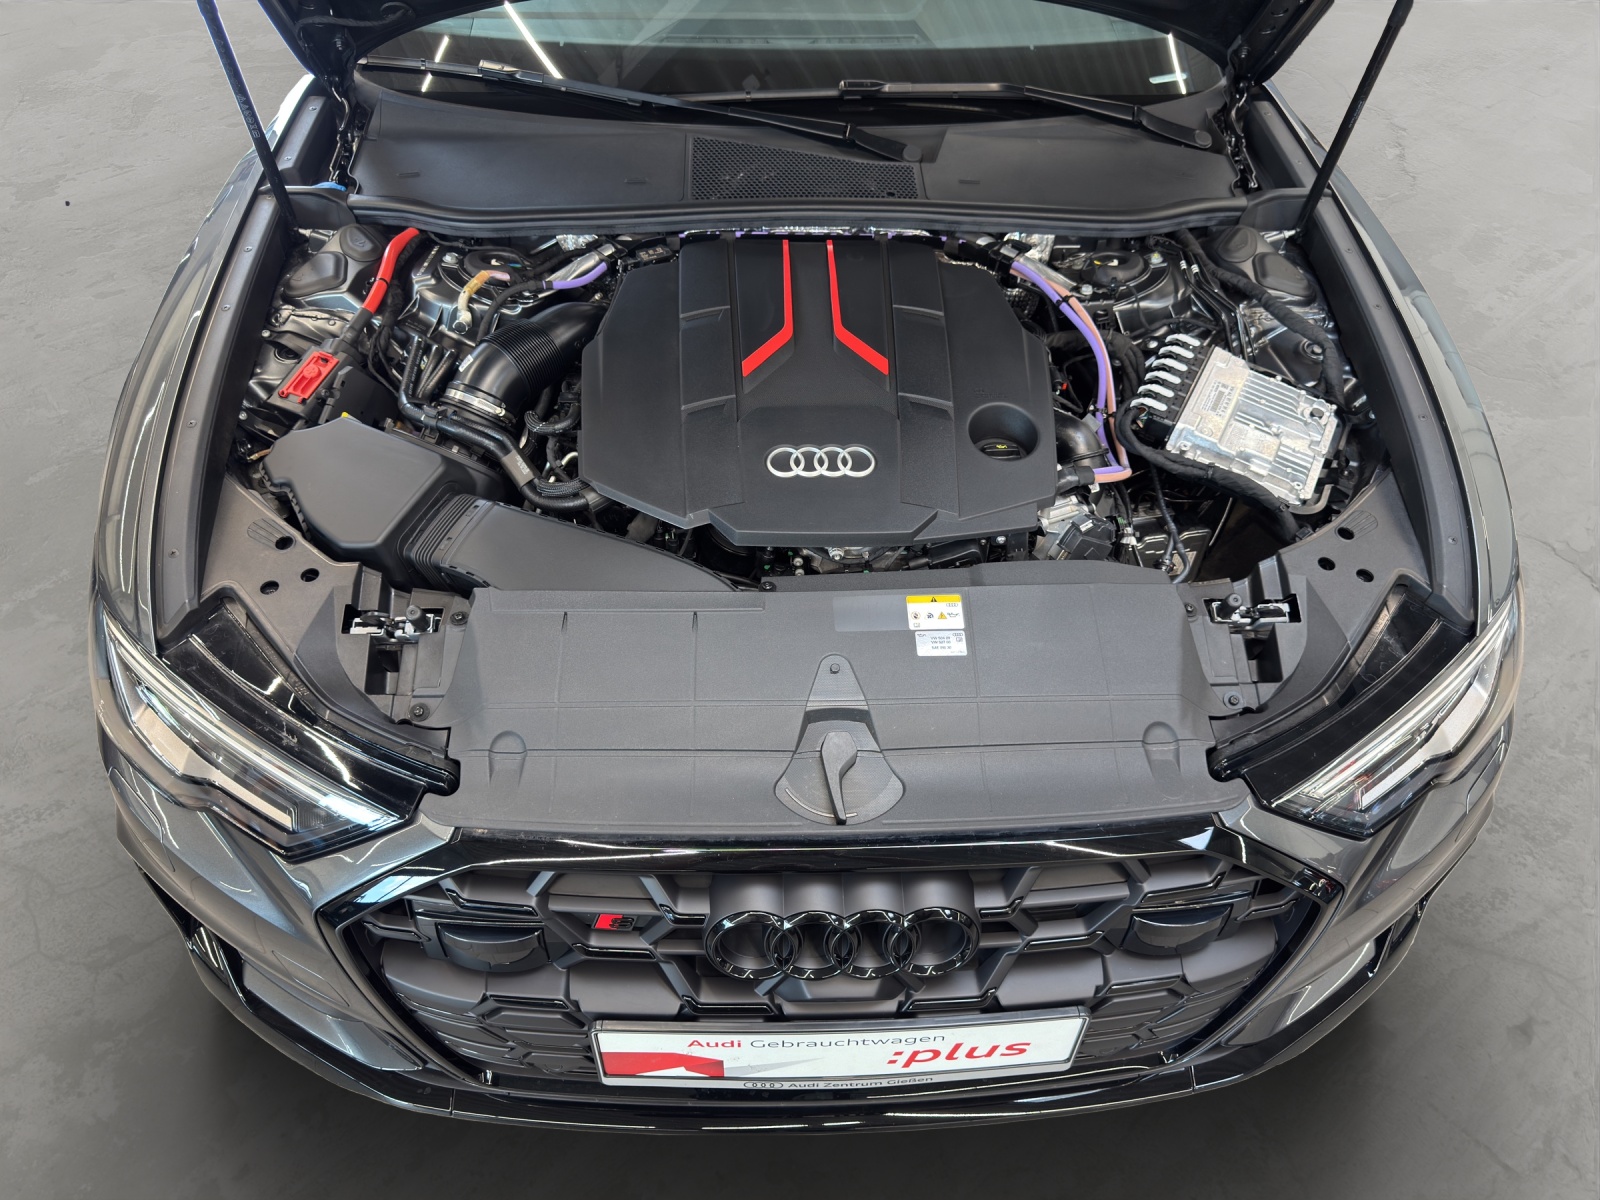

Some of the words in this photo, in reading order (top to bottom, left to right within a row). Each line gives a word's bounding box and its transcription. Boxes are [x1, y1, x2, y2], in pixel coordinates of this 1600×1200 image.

[687, 1039, 742, 1048] Audi
[750, 1034, 945, 1049] Gebrauchtwagen
[887, 1077, 933, 1085] Gießen
